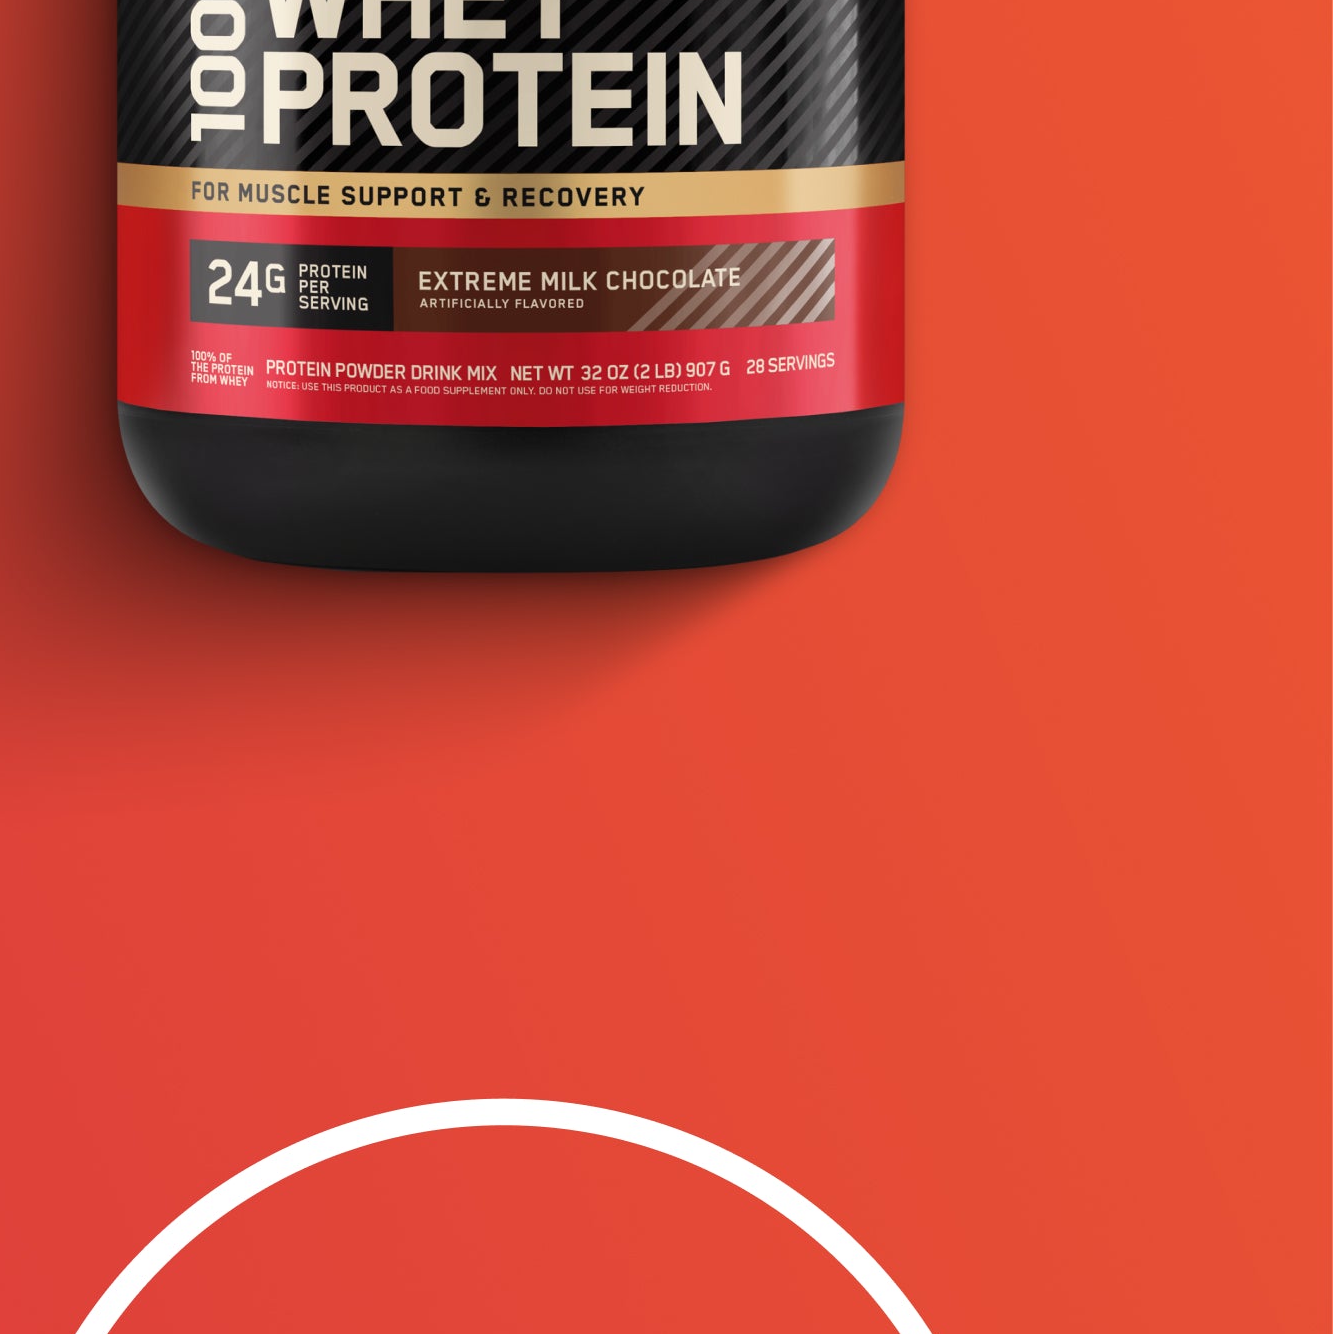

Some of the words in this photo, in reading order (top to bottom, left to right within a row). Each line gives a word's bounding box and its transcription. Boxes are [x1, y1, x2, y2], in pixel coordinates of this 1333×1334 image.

[262, 51, 743, 148] PROTEIN
[191, 180, 229, 202] FOR
[238, 182, 330, 205] MUSCLE
[341, 185, 463, 207] SUPPORT
[475, 187, 491, 207] &
[502, 186, 645, 207] RECOVERY
[298, 263, 367, 280] PROTEIN
[418, 270, 532, 292] EXTREME
[540, 271, 598, 291] MILK
[606, 267, 741, 291] CHOCOLATE
[298, 279, 330, 294] PER
[298, 295, 369, 312] SERVING
[419, 297, 510, 309] ARTIFICIALLY
[514, 298, 584, 309] FLAVORED
[190, 350, 217, 362] 100%
[219, 352, 233, 363] OF
[190, 361, 209, 373] THE
[211, 363, 254, 376] PROTEIN
[266, 359, 331, 378] PROTEIN
[335, 362, 406, 380] POWDER
[411, 364, 462, 380] DRINK
[467, 365, 498, 381] MIX
[510, 365, 544, 381] NET
[547, 365, 575, 381] WT
[580, 365, 603, 381] 32
[607, 364, 629, 381] OZ
[633, 363, 650, 381] (2
[654, 362, 682, 380] LB)
[686, 361, 715, 378] 907
[719, 360, 731, 377] G
[746, 358, 765, 375] 28
[768, 352, 835, 373] SERVINGS
[190, 372, 217, 385] FROM
[219, 375, 249, 387] WHEY
[266, 380, 300, 390] NOTICE:
[301, 382, 319, 391] USE
[322, 383, 342, 392] THIS
[344, 383, 387, 394] PRODUCT
[389, 385, 403, 394] AS
[405, 385, 412, 394] A
[414, 385, 440, 395] FOOD
[443, 386, 507, 395] SUPPLEMENT
[510, 386, 536, 395] ONLY.
[539, 386, 552, 395] DO
[555, 386, 574, 395] NOT
[577, 386, 596, 395] USE
[599, 385, 618, 395] FOR
[621, 384, 657, 394] WEIGHT
[659, 382, 713, 393] REDUCTION.
